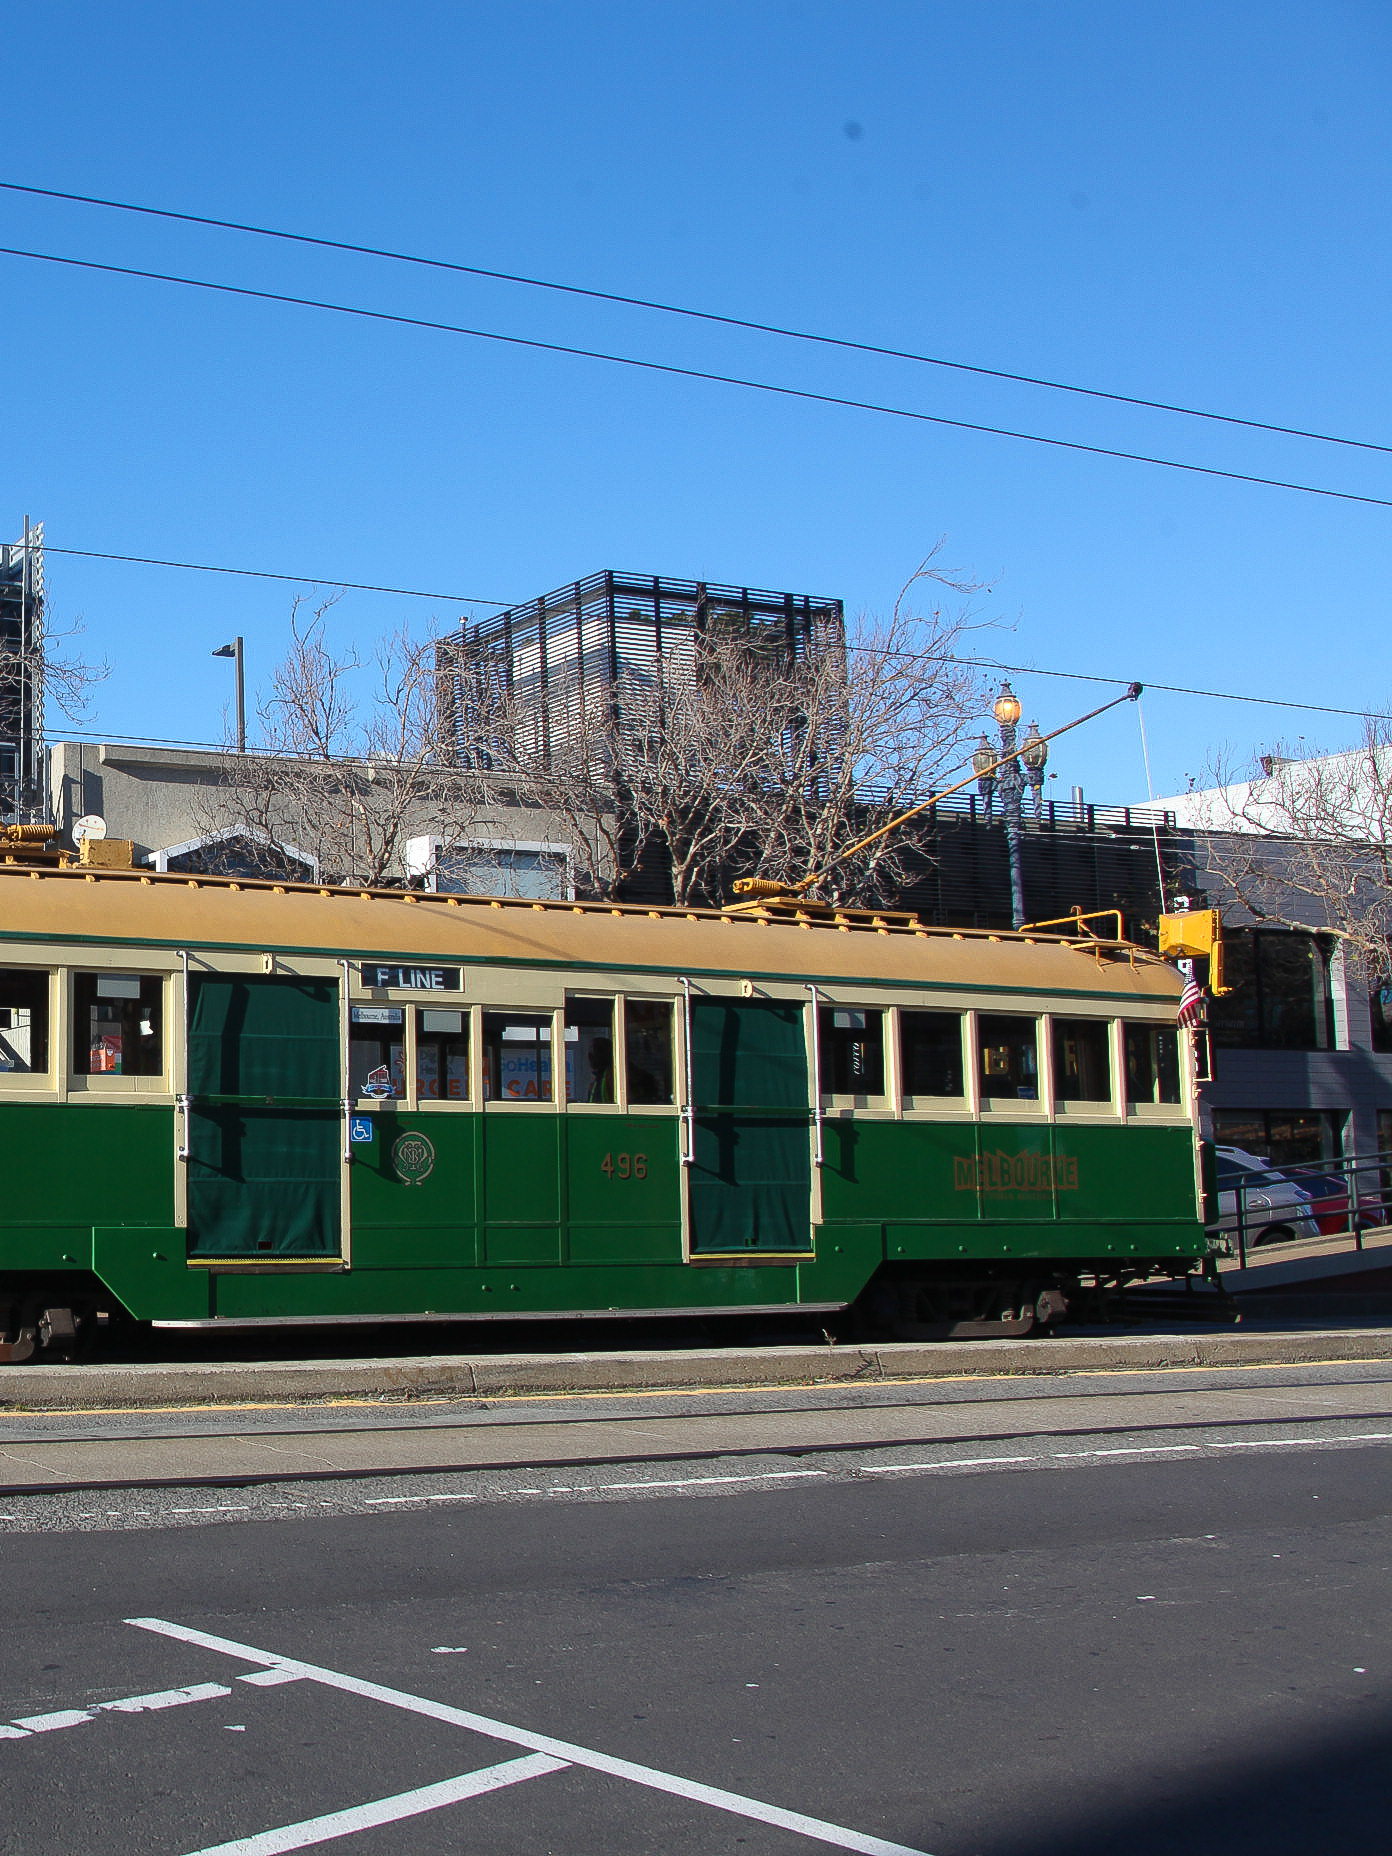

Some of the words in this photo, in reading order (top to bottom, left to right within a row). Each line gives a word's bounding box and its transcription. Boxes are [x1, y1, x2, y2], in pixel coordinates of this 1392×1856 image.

[376, 967, 389, 987] F
[398, 968, 445, 989] LINE
[600, 1152, 649, 1180] 496
[955, 1151, 1078, 1190] MELBOURNE
